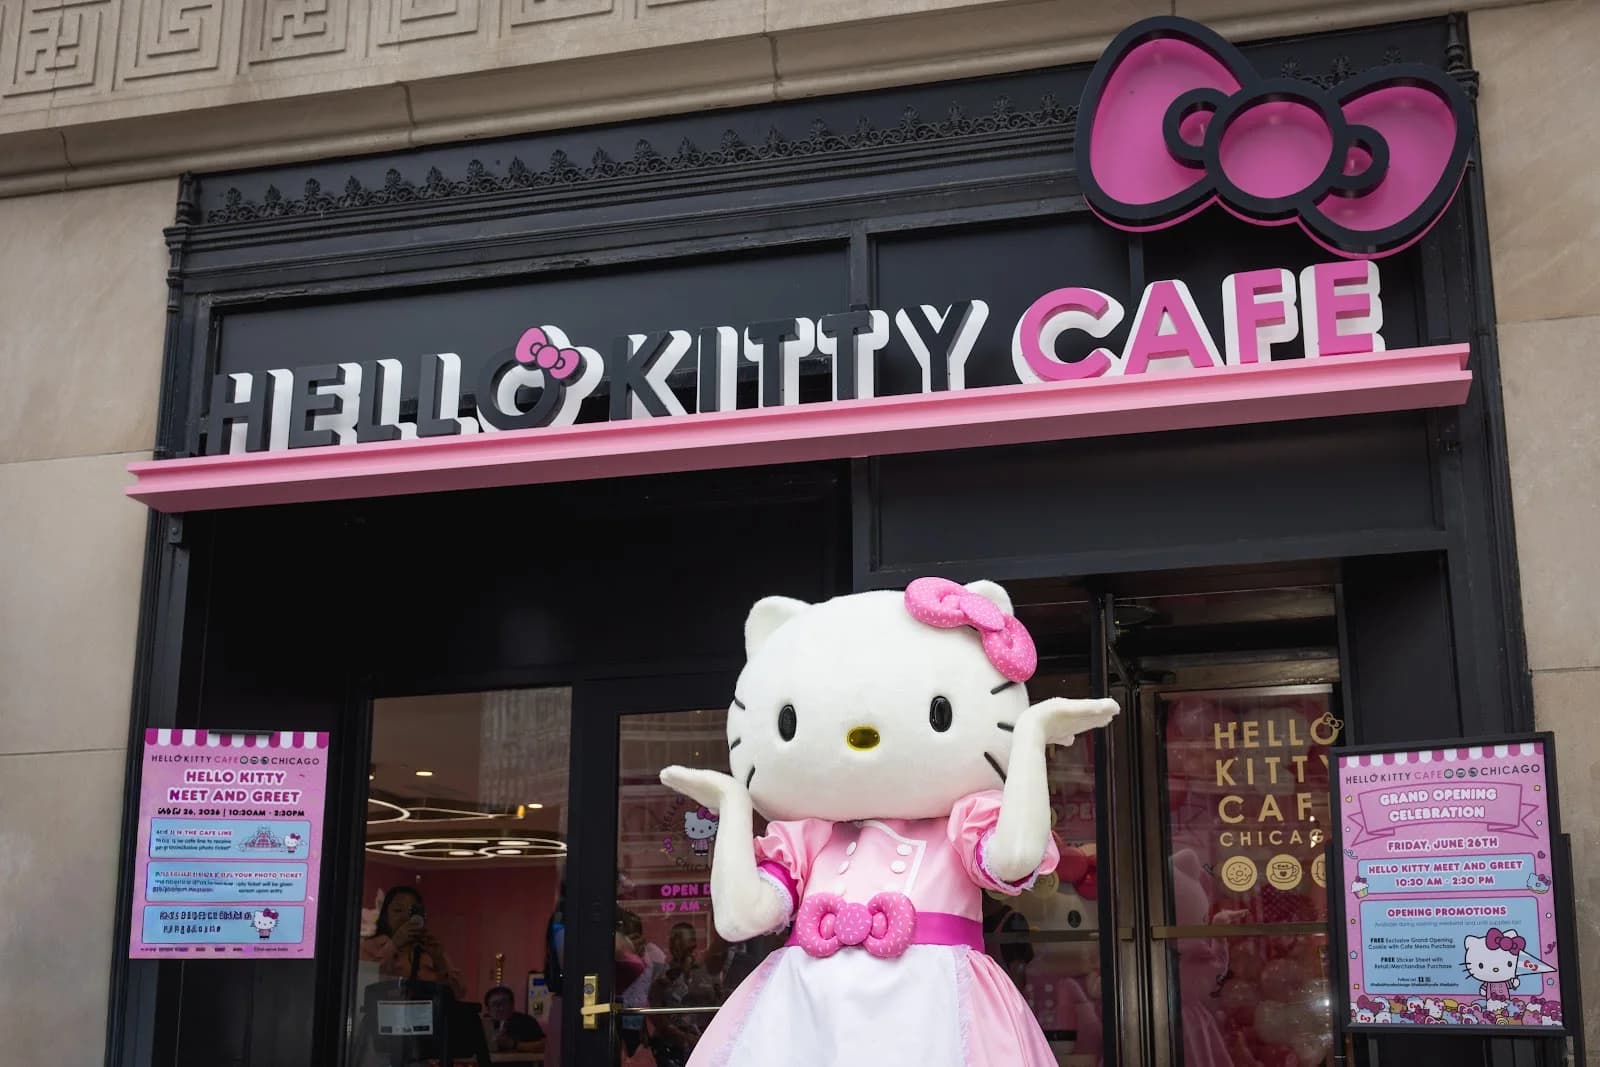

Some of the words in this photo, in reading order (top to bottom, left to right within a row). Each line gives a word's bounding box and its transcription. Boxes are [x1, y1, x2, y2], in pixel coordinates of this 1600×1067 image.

[205, 325, 604, 456] HELLO
[608, 300, 989, 422] KITTY
[1012, 260, 1386, 384] CAFE
[1214, 712, 1344, 749] HELLO
[151, 754, 182, 763] HELLO
[184, 755, 211, 763] KITTY
[214, 756, 239, 764] CAFE
[271, 757, 319, 765] CHICAGO
[185, 770, 235, 783] HELLO
[239, 771, 285, 784] KITTY
[1345, 773, 1378, 785] HELLO
[1380, 772, 1411, 782] KITTY
[1414, 770, 1442, 780] CAFE
[1480, 764, 1540, 776] CHICAGO
[212, 790, 247, 802] AND
[252, 791, 300, 803] GREET
[1379, 789, 1429, 807] GRAND
[1432, 788, 1498, 801] OPENING
[1218, 792, 1331, 824] CAF
[1388, 805, 1486, 823] CELEBRATION
[1219, 830, 1324, 847] CHICAG
[1433, 839, 1464, 849] JUNE
[1467, 837, 1498, 848] 26TH
[1368, 865, 1399, 874] HELLO
[1401, 864, 1430, 873] KITTY
[1433, 862, 1460, 872] MEET
[1463, 861, 1486, 871] AND
[1489, 860, 1523, 870] GREET
[1395, 878, 1424, 887] 10:30
[1426, 877, 1442, 886] AM
[1452, 876, 1475, 885] 2:30
[1478, 875, 1494, 885] PM
[661, 882, 699, 897] OPEN
[680, 900, 700, 911] AM
[1387, 907, 1432, 918] OPENING
[1435, 905, 1507, 916] PROMOTIONS
